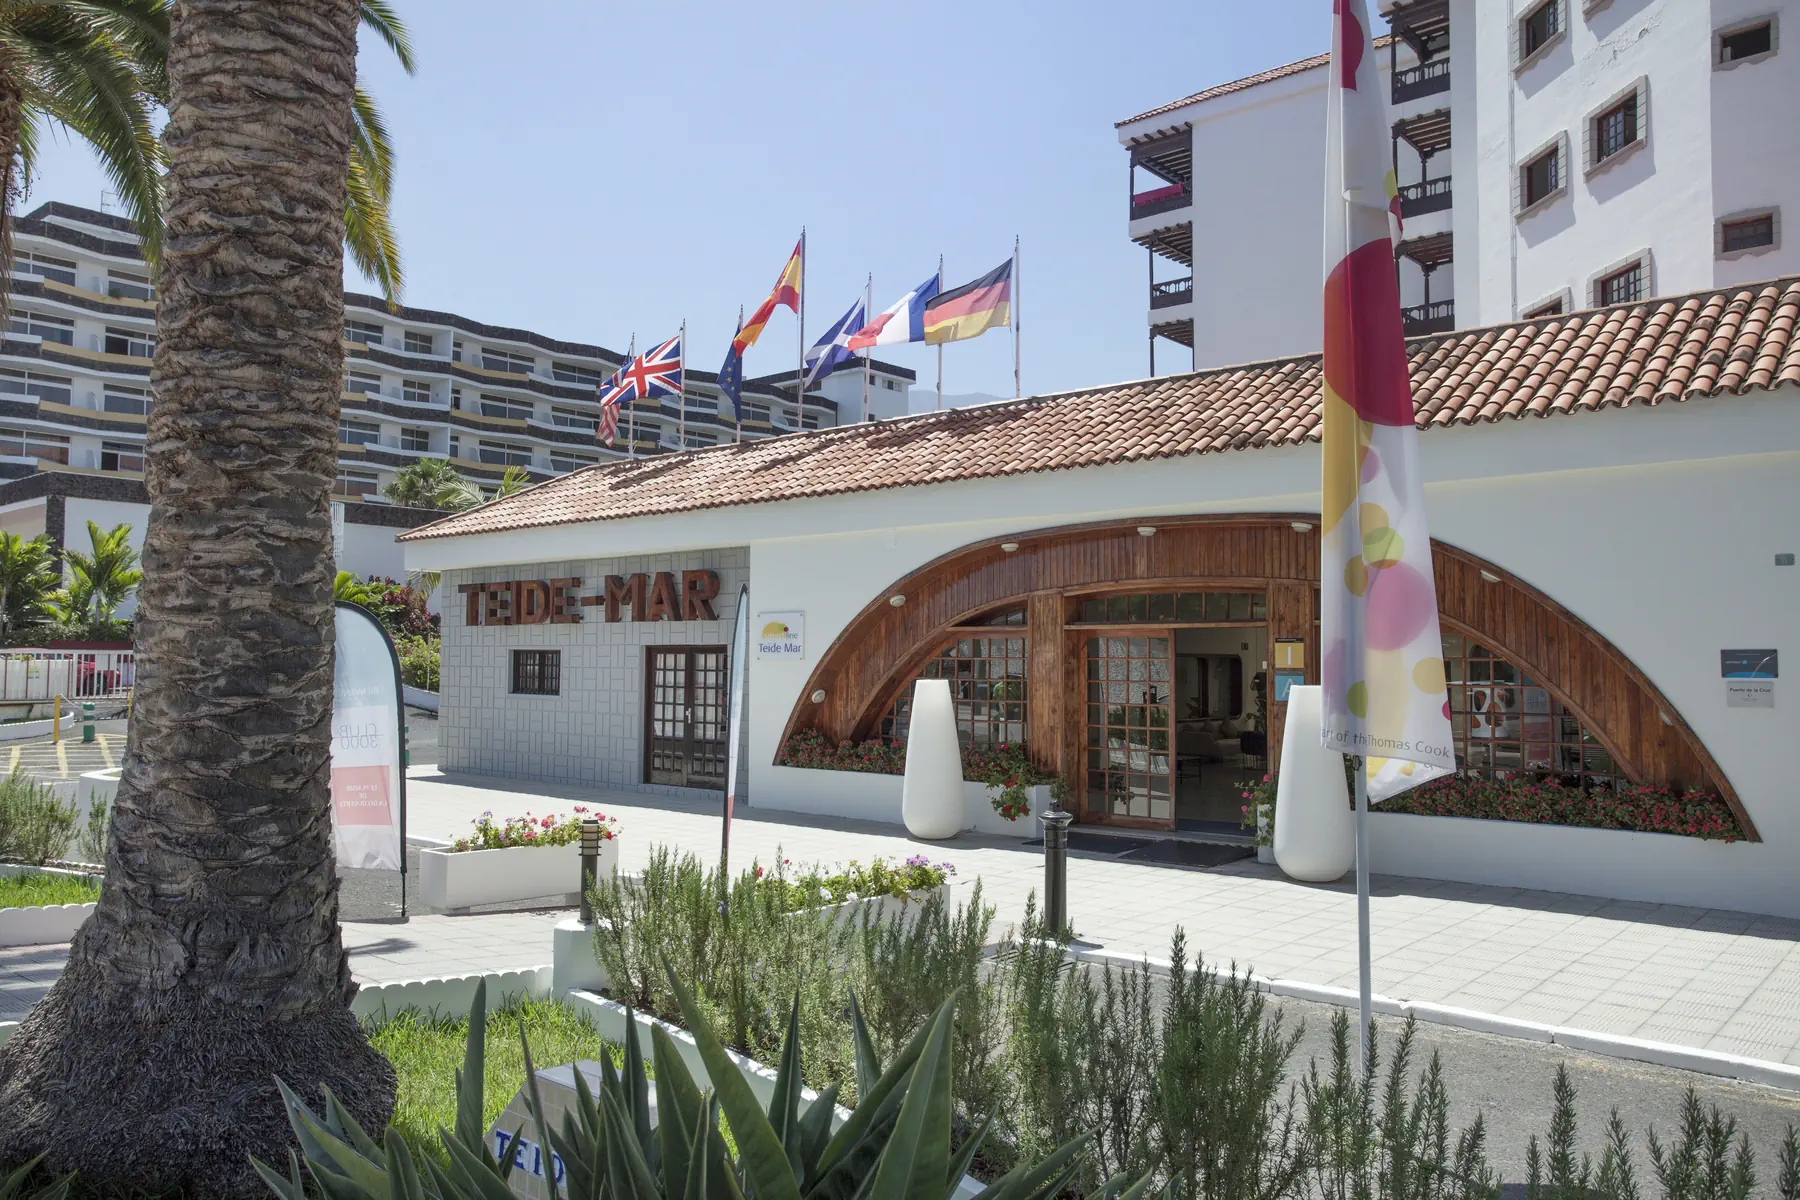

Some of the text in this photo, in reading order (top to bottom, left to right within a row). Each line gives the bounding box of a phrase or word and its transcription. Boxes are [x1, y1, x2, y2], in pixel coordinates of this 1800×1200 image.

[458, 569, 720, 626] TEIDE-MAR
[759, 642, 802, 653] Teide Mar
[1336, 730, 1350, 742] of
[1368, 734, 1411, 751] Thomas
[1415, 740, 1450, 758] Cook
